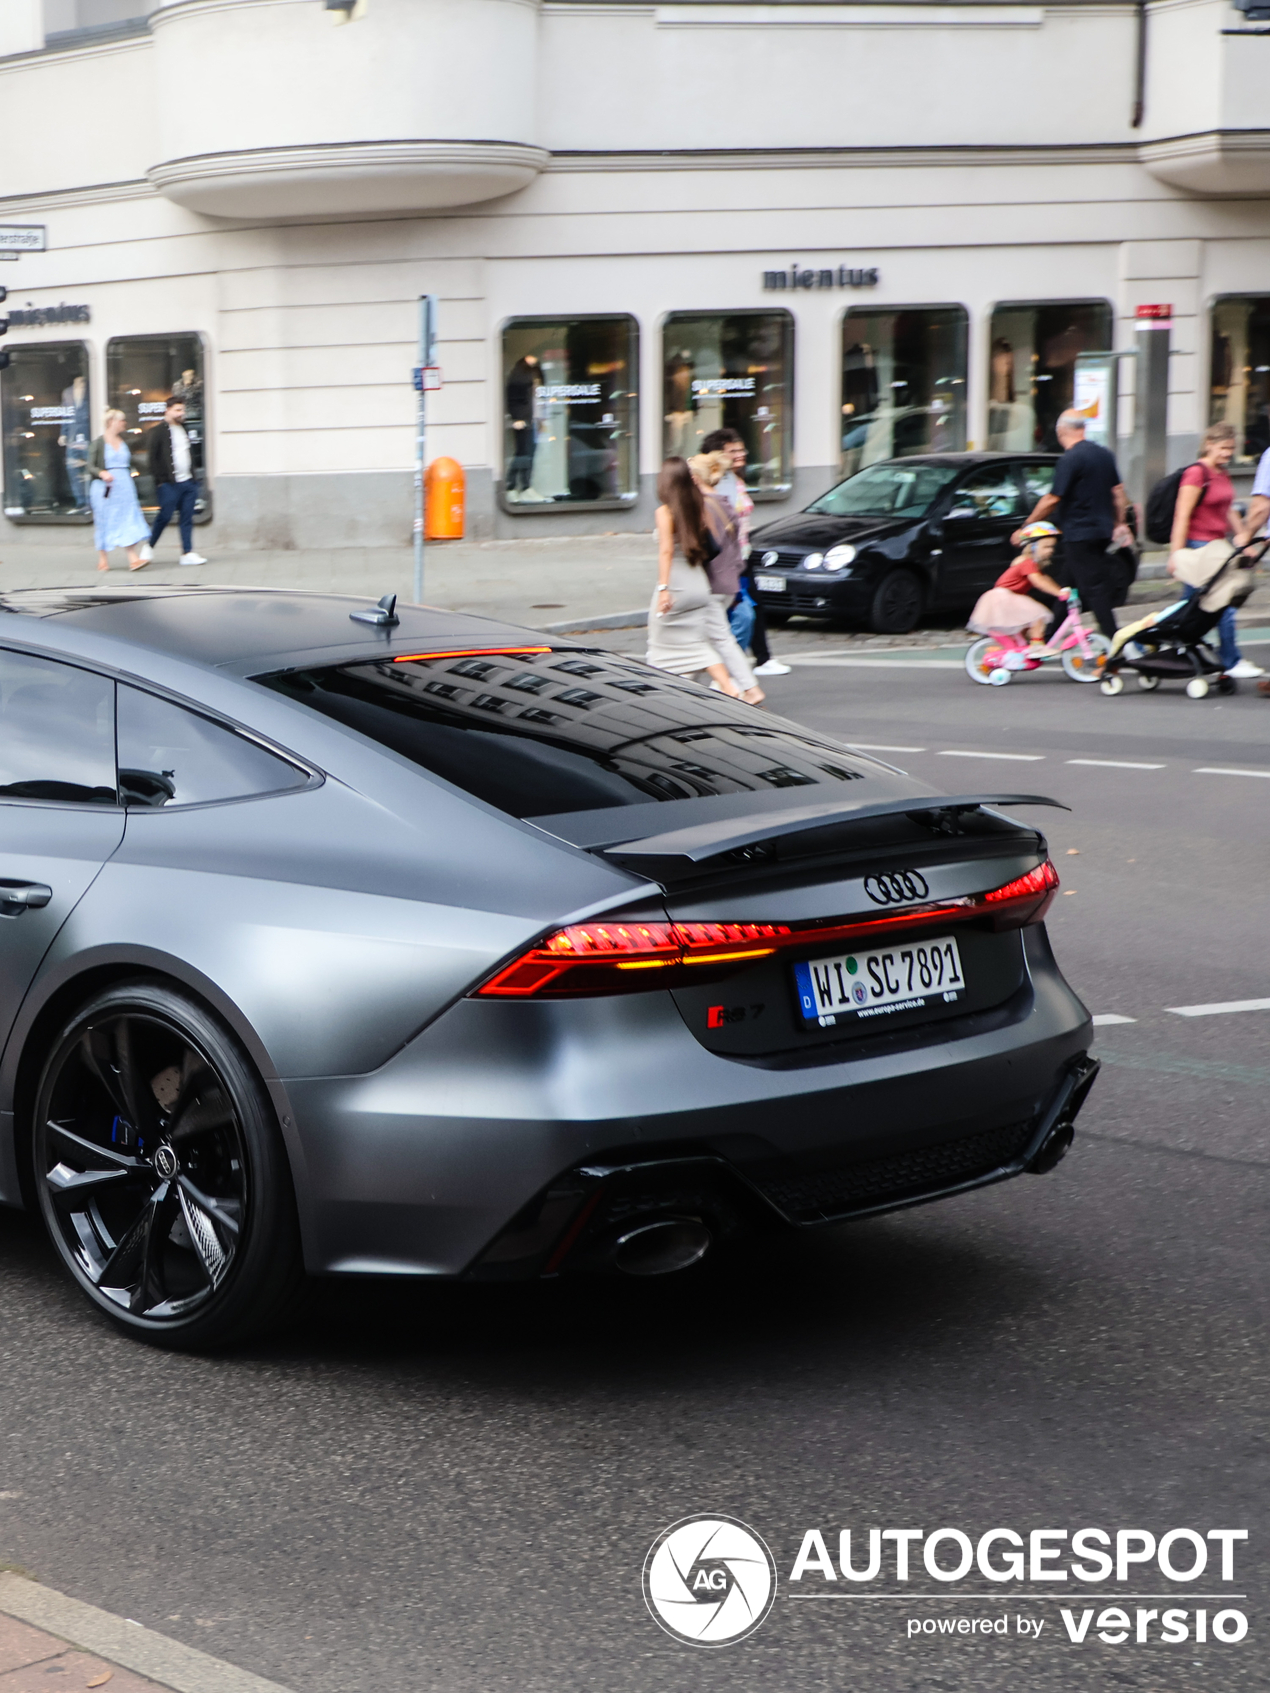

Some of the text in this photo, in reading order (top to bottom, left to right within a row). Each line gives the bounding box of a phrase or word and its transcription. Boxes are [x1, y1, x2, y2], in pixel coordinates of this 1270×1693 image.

[762, 262, 878, 289] mientus
[813, 962, 850, 1008] WI
[803, 996, 812, 1009] D
